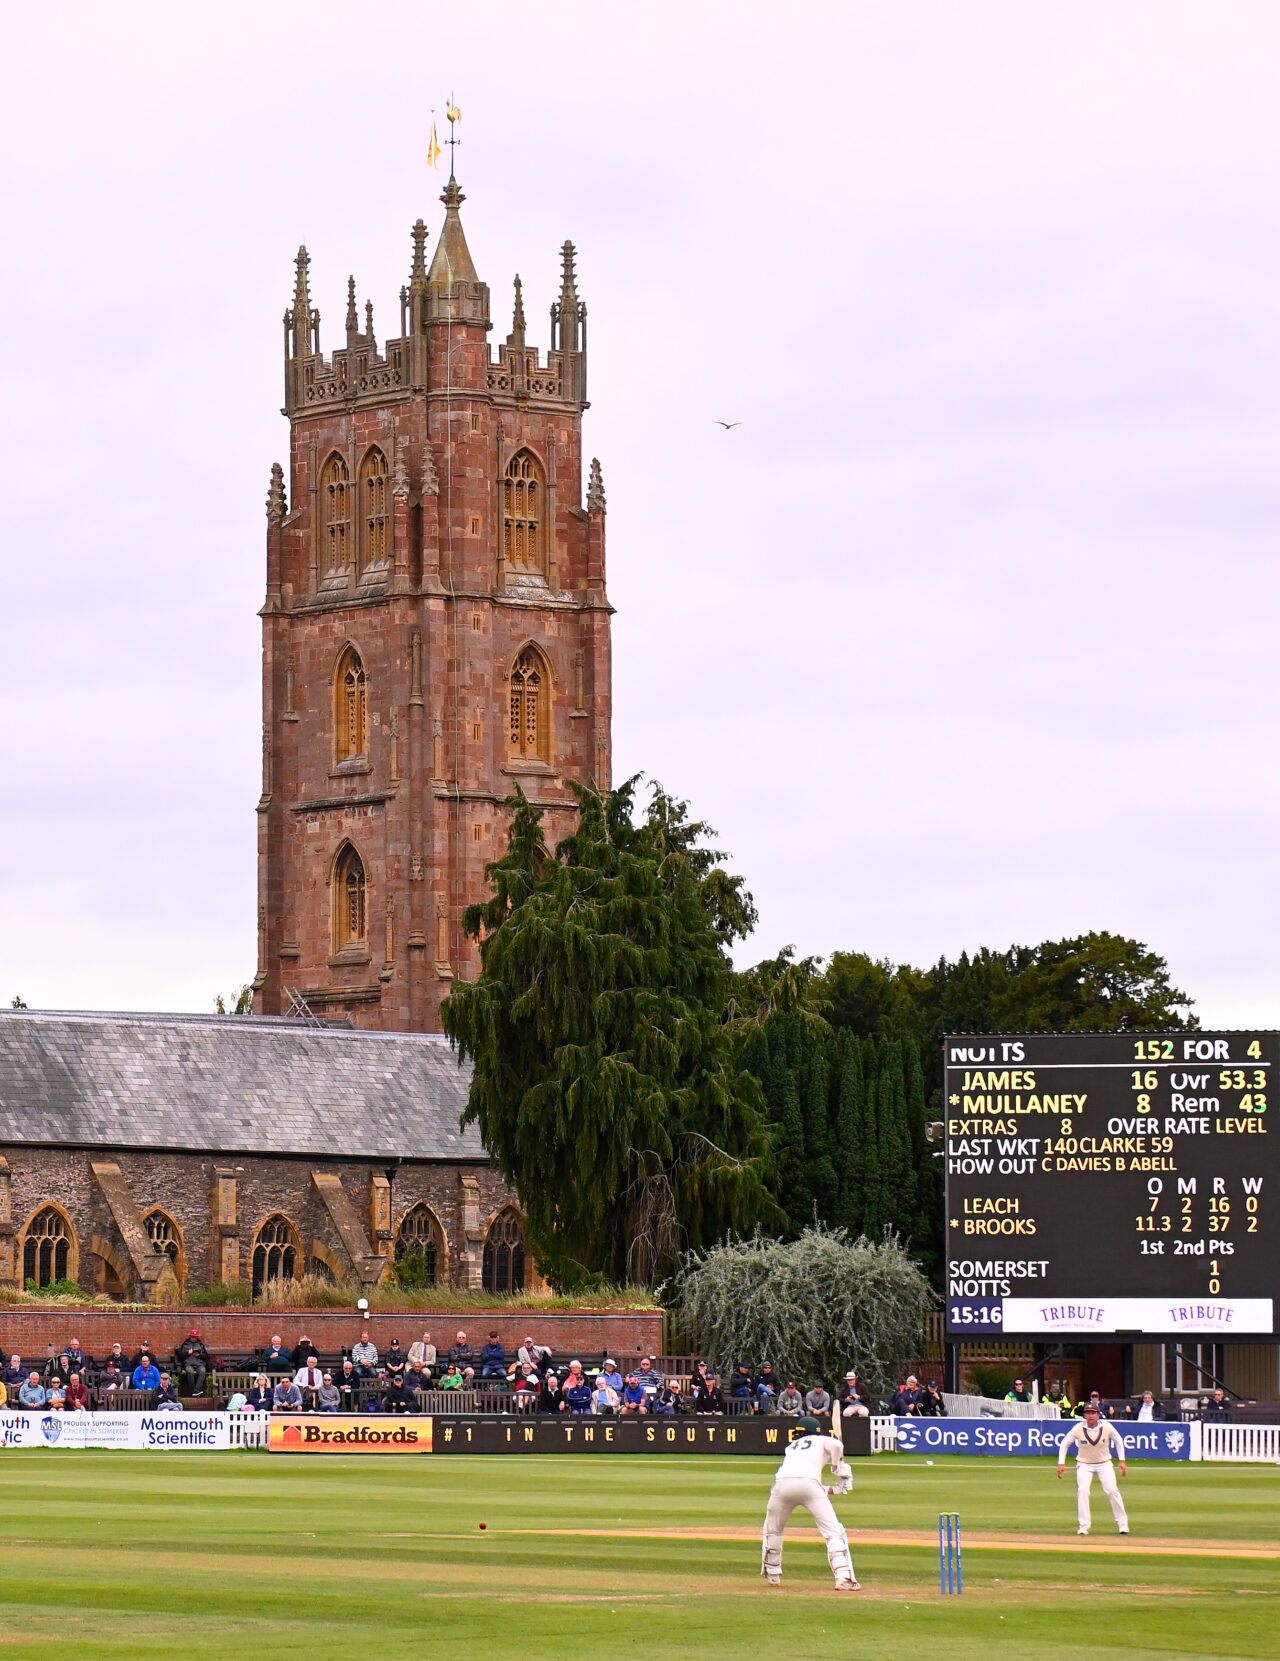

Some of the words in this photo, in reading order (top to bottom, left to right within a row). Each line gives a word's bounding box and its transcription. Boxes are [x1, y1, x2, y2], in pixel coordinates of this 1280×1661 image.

[1135, 1040, 1174, 1060] 152
[1184, 1040, 1229, 1059] FOR
[1247, 1041, 1262, 1059] 4
[962, 1071, 1036, 1090] JAMES
[1132, 1071, 1158, 1089] 16
[1171, 1073, 1210, 1090] Ovr
[1220, 1070, 1266, 1089] 53.3
[964, 1095, 1087, 1114] MULLANEY
[1137, 1094, 1150, 1113] 8
[1172, 1094, 1219, 1113] Rem
[1239, 1094, 1266, 1113] 43
[949, 1119, 1017, 1135] EXTRAS
[1061, 1119, 1072, 1134] 8
[1108, 1118, 1159, 1134] OVER
[1165, 1118, 1210, 1134] RATE
[1216, 1118, 1267, 1133] LEVEL
[949, 1139, 992, 1155] LAST
[997, 1139, 1040, 1155] WKT
[1044, 1138, 1078, 1154] 140
[1080, 1137, 1146, 1153] CLARKE
[1152, 1137, 1173, 1153] 59
[949, 1159, 994, 1174] HOW
[999, 1159, 1037, 1174] OUT
[1042, 1158, 1052, 1171] C
[1057, 1157, 1111, 1171] DAVIES
[1116, 1157, 1126, 1171] B
[1130, 1157, 1177, 1170] ABELL
[1148, 1178, 1162, 1194] O
[1178, 1178, 1196, 1194] M
[1214, 1178, 1225, 1194] R
[1242, 1178, 1262, 1194] W
[965, 1198, 1019, 1214] LEACH
[1149, 1197, 1158, 1212] 7
[1182, 1198, 1191, 1213] 2
[1209, 1197, 1230, 1212] 16
[1246, 1197, 1258, 1212] 0
[965, 1219, 1036, 1234] BROOKS
[1136, 1216, 1171, 1231] 11.3
[1182, 1217, 1192, 1232] 2
[1209, 1216, 1230, 1231] 37
[1248, 1217, 1257, 1232] 2
[1141, 1240, 1164, 1254] 1st
[1174, 1240, 1204, 1255] 2nd
[1209, 1240, 1234, 1254] Pts
[950, 1261, 1049, 1277] SOMERSET
[1210, 1260, 1219, 1275] 1
[950, 1280, 1011, 1296] NOTTS
[1209, 1279, 1220, 1294] 0
[952, 1307, 1002, 1323] 15:16
[1040, 1306, 1105, 1322] TRIBUTE
[1169, 1306, 1234, 1322] TRIBUTE
[40, 1421, 63, 1431] MSL
[141, 1417, 223, 1431] Monmouth
[148, 1431, 216, 1444] Scientific
[304, 1425, 418, 1443] Bradfords
[507, 1428, 533, 1441] IN
[565, 1428, 613, 1441] THE
[647, 1428, 735, 1442] SOUTH
[766, 1428, 841, 1443] WET
[926, 1427, 968, 1445] One
[975, 1428, 1021, 1451] Step
[1028, 1426, 1158, 1450] Recent
